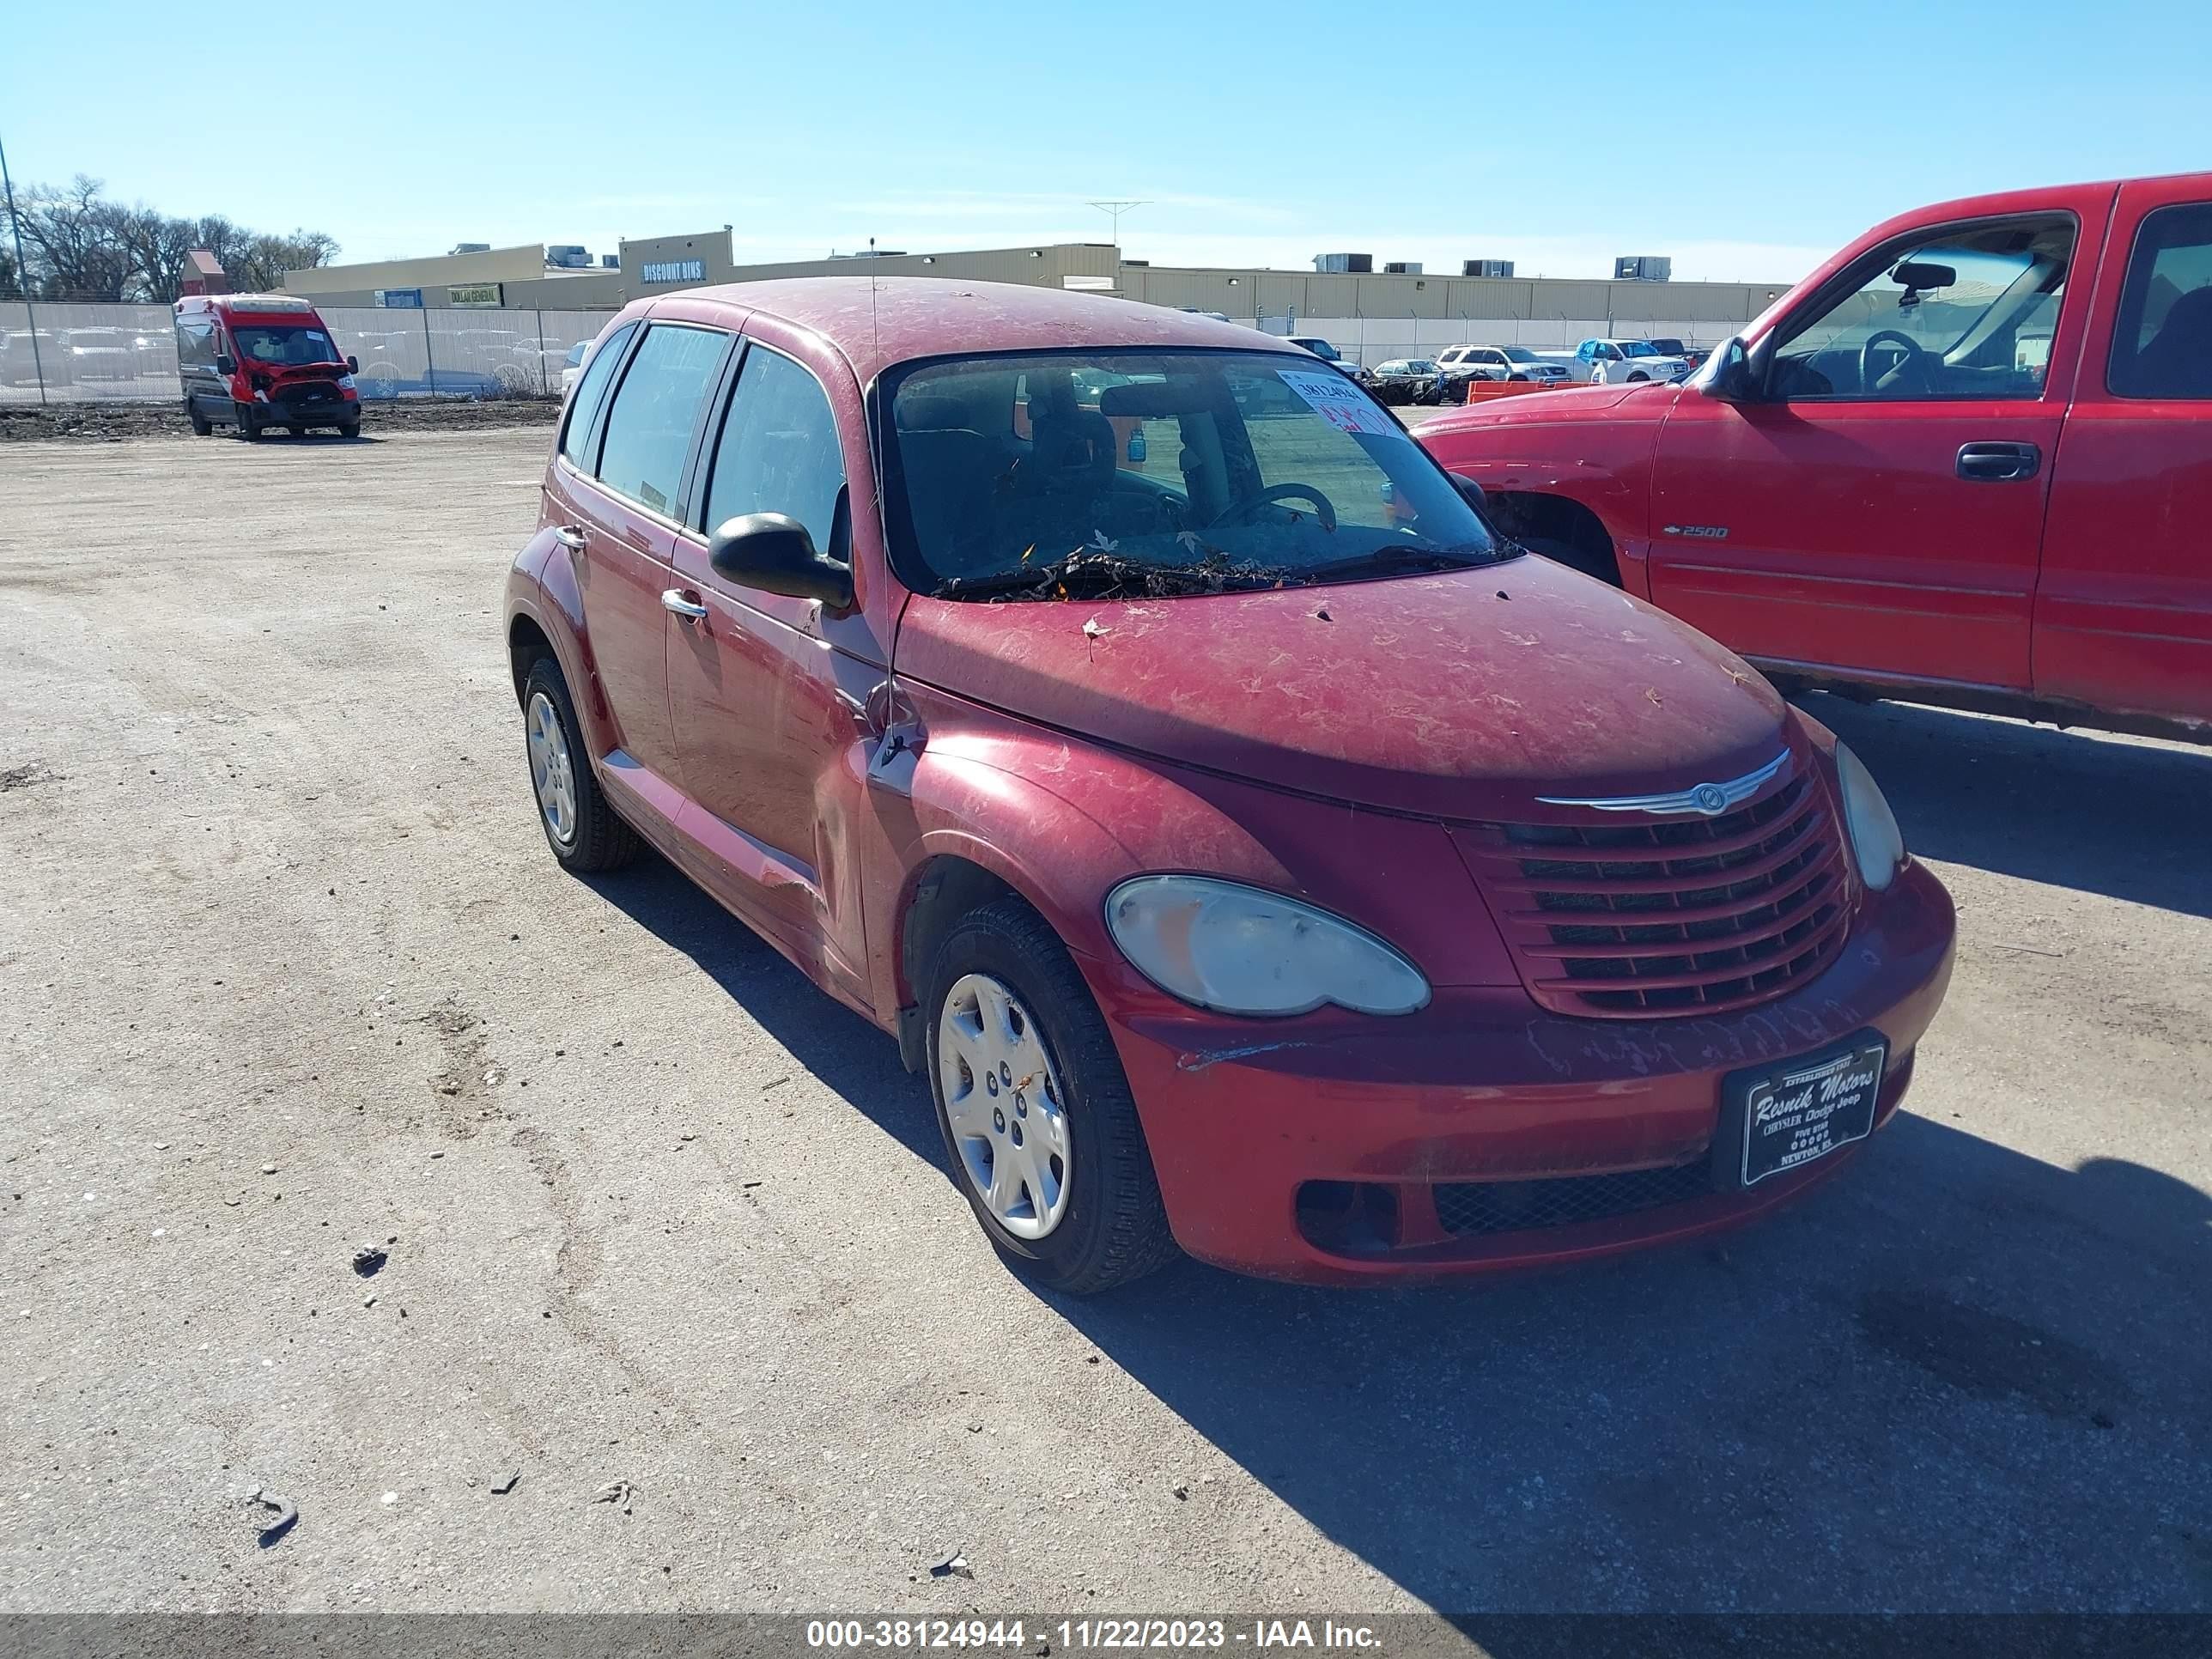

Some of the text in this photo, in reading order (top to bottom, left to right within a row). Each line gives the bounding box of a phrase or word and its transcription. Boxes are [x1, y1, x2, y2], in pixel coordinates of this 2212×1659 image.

[643, 260, 702, 282] DISCOUNT BINS
[451, 288, 496, 303] DOLLAR GENERAL
[1297, 384, 1363, 401] 38124944
[1683, 526, 1729, 538] 2500
[1785, 1067, 1835, 1086] ESTABLISHED
[1755, 1071, 1875, 1126] Resnik Motors
[1764, 1093, 1861, 1136] CHRYSLER Dodge Jeep
[1795, 1121, 1829, 1139] FIVE STAR
